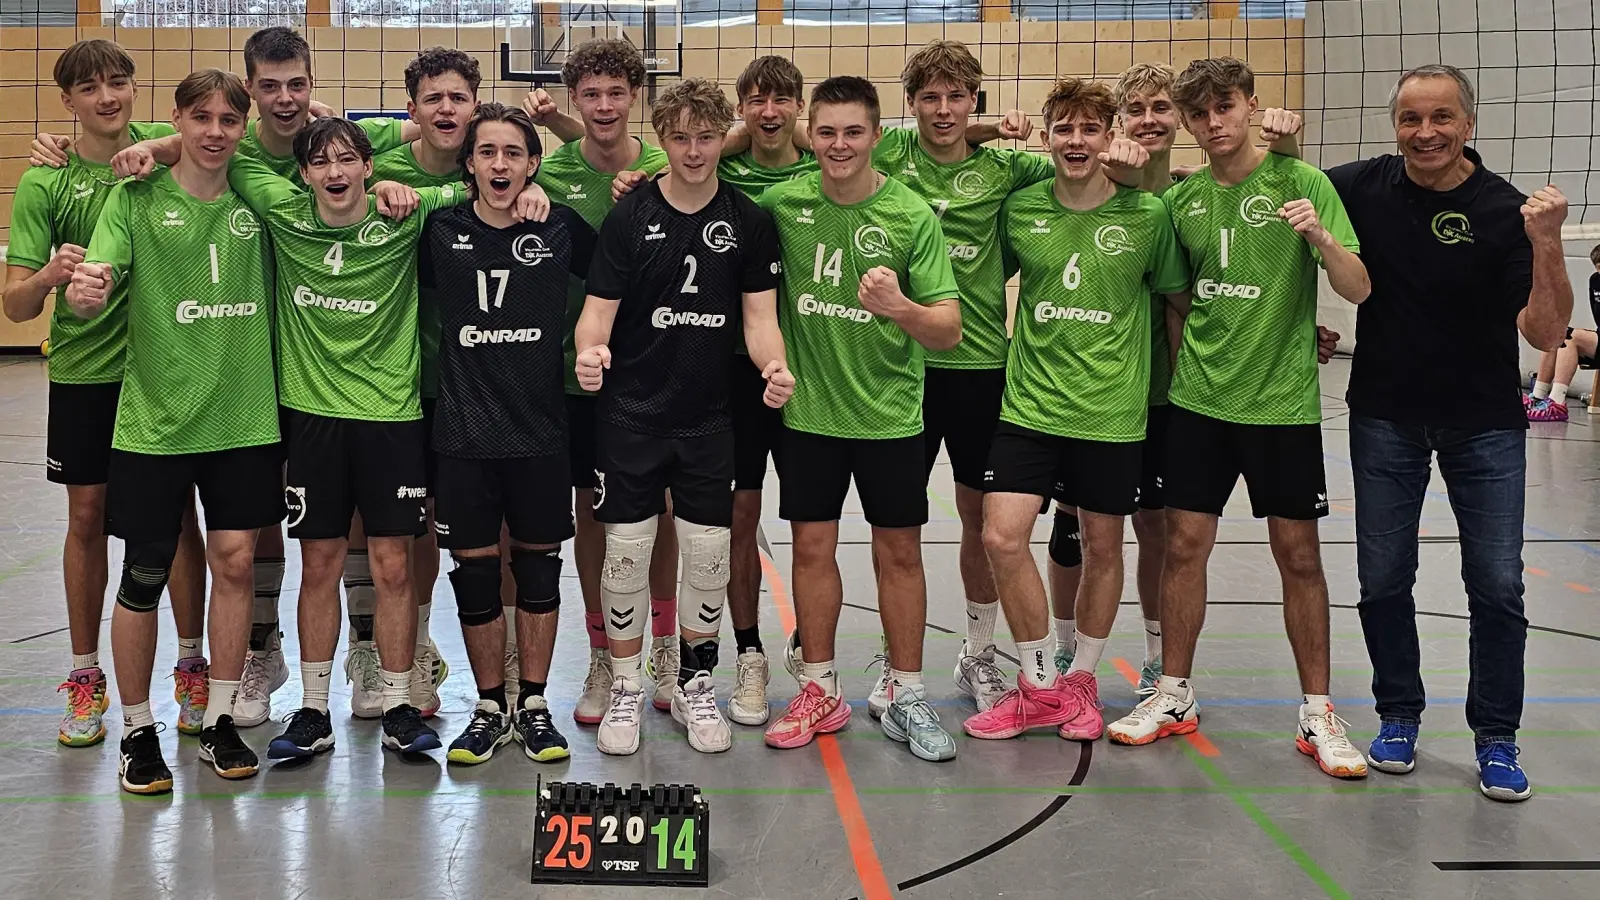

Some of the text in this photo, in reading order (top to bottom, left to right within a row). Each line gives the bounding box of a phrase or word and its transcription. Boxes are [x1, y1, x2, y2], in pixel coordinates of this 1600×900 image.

[796, 216, 815, 225] erima
[452, 242, 474, 250] erima
[644, 232, 667, 241] erima
[323, 241, 345, 276] 4
[813, 242, 843, 287] 14
[680, 254, 699, 294] 2
[1062, 252, 1082, 291] 6
[293, 285, 377, 314] CONRAD
[476, 269, 511, 313] 17
[1197, 278, 1261, 299] CORAD
[176, 300, 258, 324] CONRAD
[651, 306, 726, 329] CONRAD
[797, 293, 874, 323] CONRAD
[1034, 301, 1113, 324] CONRAD
[459, 325, 542, 347] CONRAD
[1035, 650, 1044, 672] CRAFT
[544, 814, 593, 869] 25
[651, 817, 697, 871] 14
[613, 860, 640, 871] TSP
